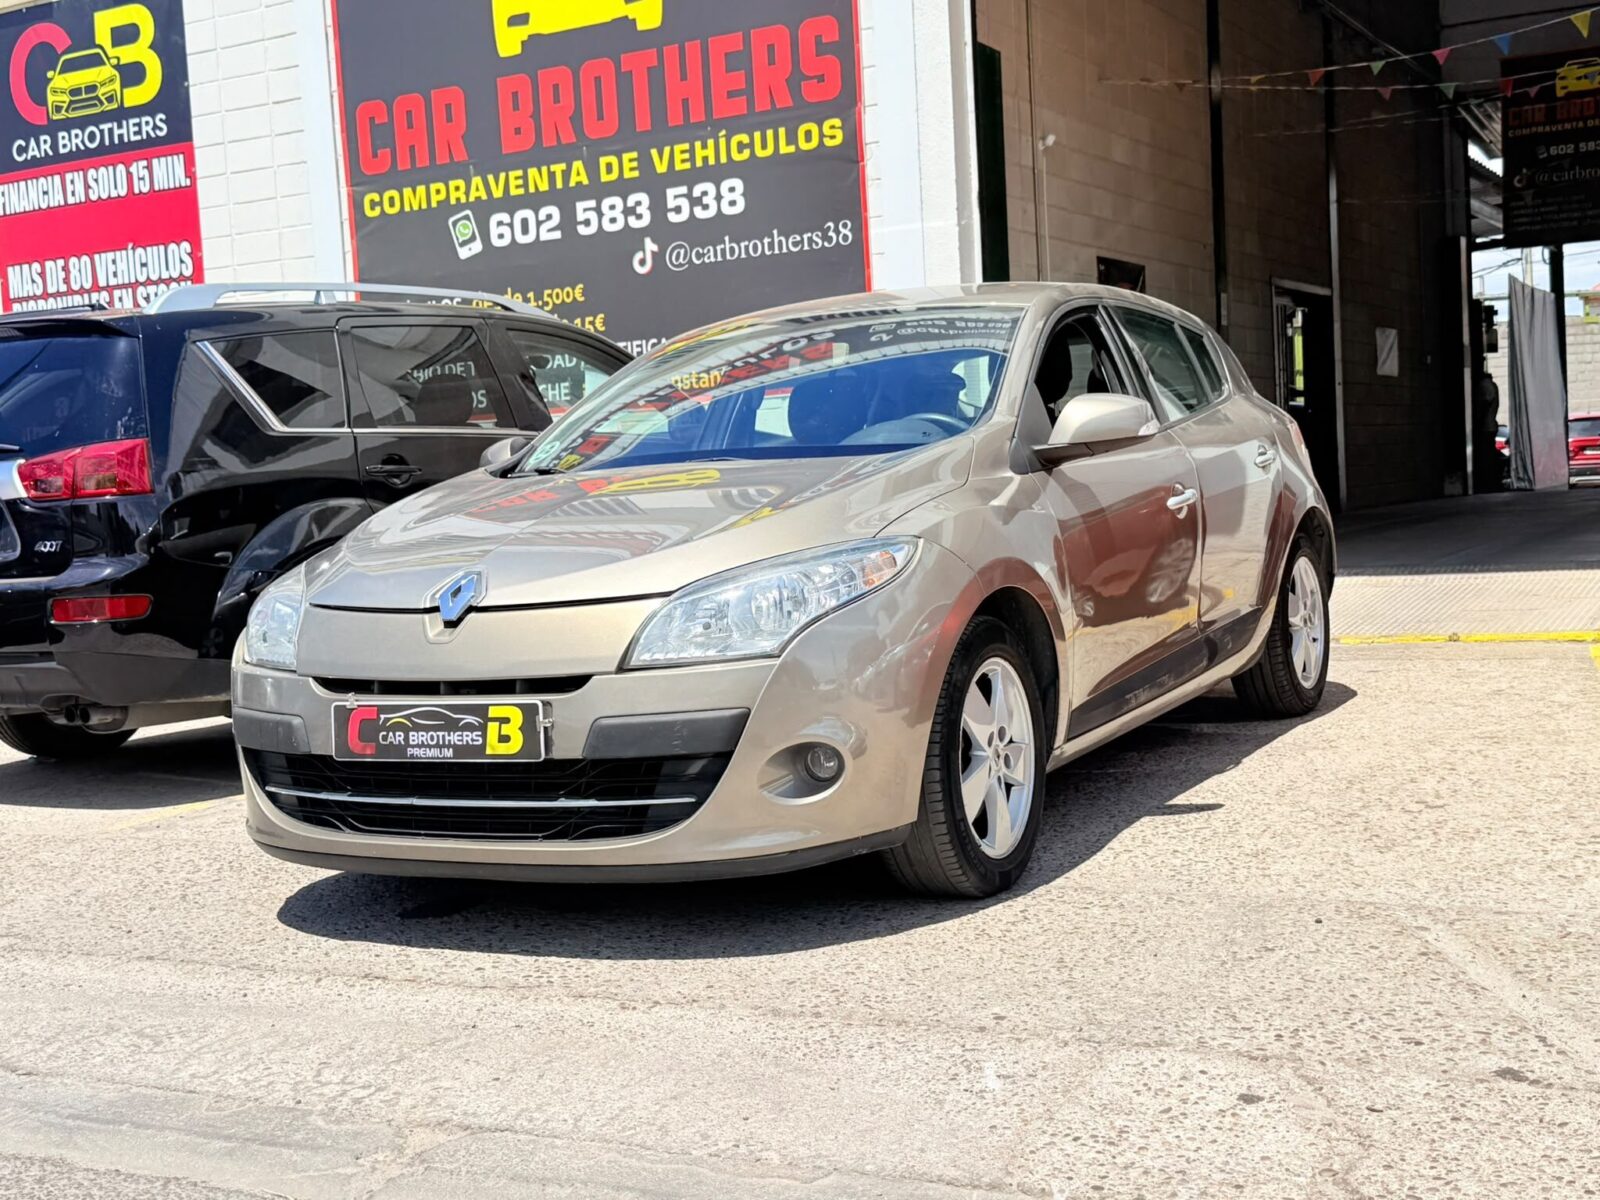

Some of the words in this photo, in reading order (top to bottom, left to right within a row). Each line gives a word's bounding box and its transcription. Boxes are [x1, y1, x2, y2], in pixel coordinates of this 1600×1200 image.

[355, 86, 469, 176] CAR
[496, 15, 842, 155] BROTHERS
[12, 134, 53, 162] CAR
[58, 113, 168, 155] BROTHERS
[1550, 144, 1575, 156] 602
[65, 171, 87, 205] EN
[87, 163, 128, 201] SOLO
[129, 160, 150, 194] 15
[152, 154, 191, 191] MIN.
[363, 160, 590, 218] COMPRAVENTA
[598, 150, 640, 182] DE
[650, 118, 844, 175] VEHÍCULOS
[489, 205, 562, 247] 602
[576, 192, 652, 236] 583
[666, 177, 746, 223] 538
[7, 262, 43, 299] MAS
[45, 258, 68, 294] DE
[69, 255, 93, 291] 80
[94, 242, 194, 288] VEHÍCULOS
[665, 219, 853, 271] @carbrothers38
[527, 284, 585, 311] 1.500€
[379, 731, 405, 745] CAR
[409, 731, 483, 745] BROTHERS
[407, 747, 453, 758] PREMIUM
